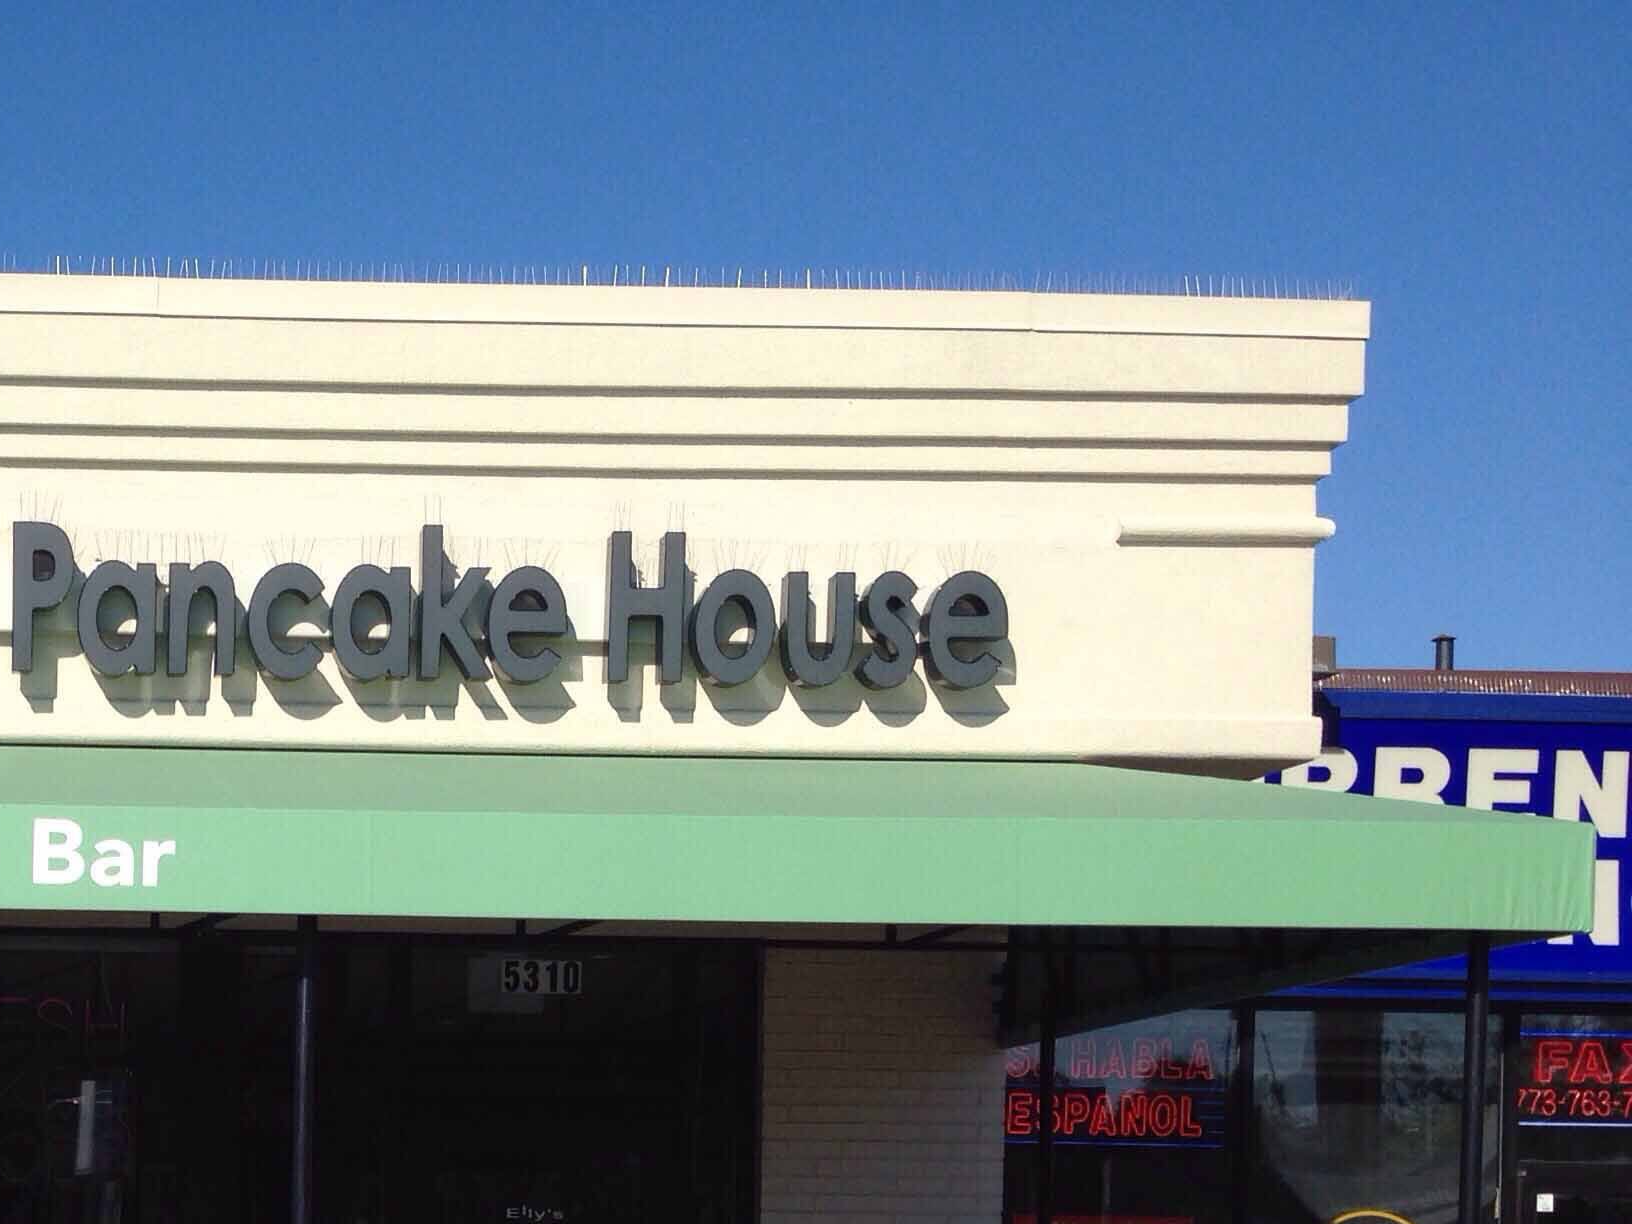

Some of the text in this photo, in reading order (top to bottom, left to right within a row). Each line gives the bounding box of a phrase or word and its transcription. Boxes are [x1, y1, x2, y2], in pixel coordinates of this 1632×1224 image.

[12, 521, 1009, 689] Pancake House
[31, 818, 176, 887] Bar
[504, 960, 580, 993] 5310
[1007, 1038, 1215, 1080] S HABLA
[505, 1204, 565, 1221] Elly's
